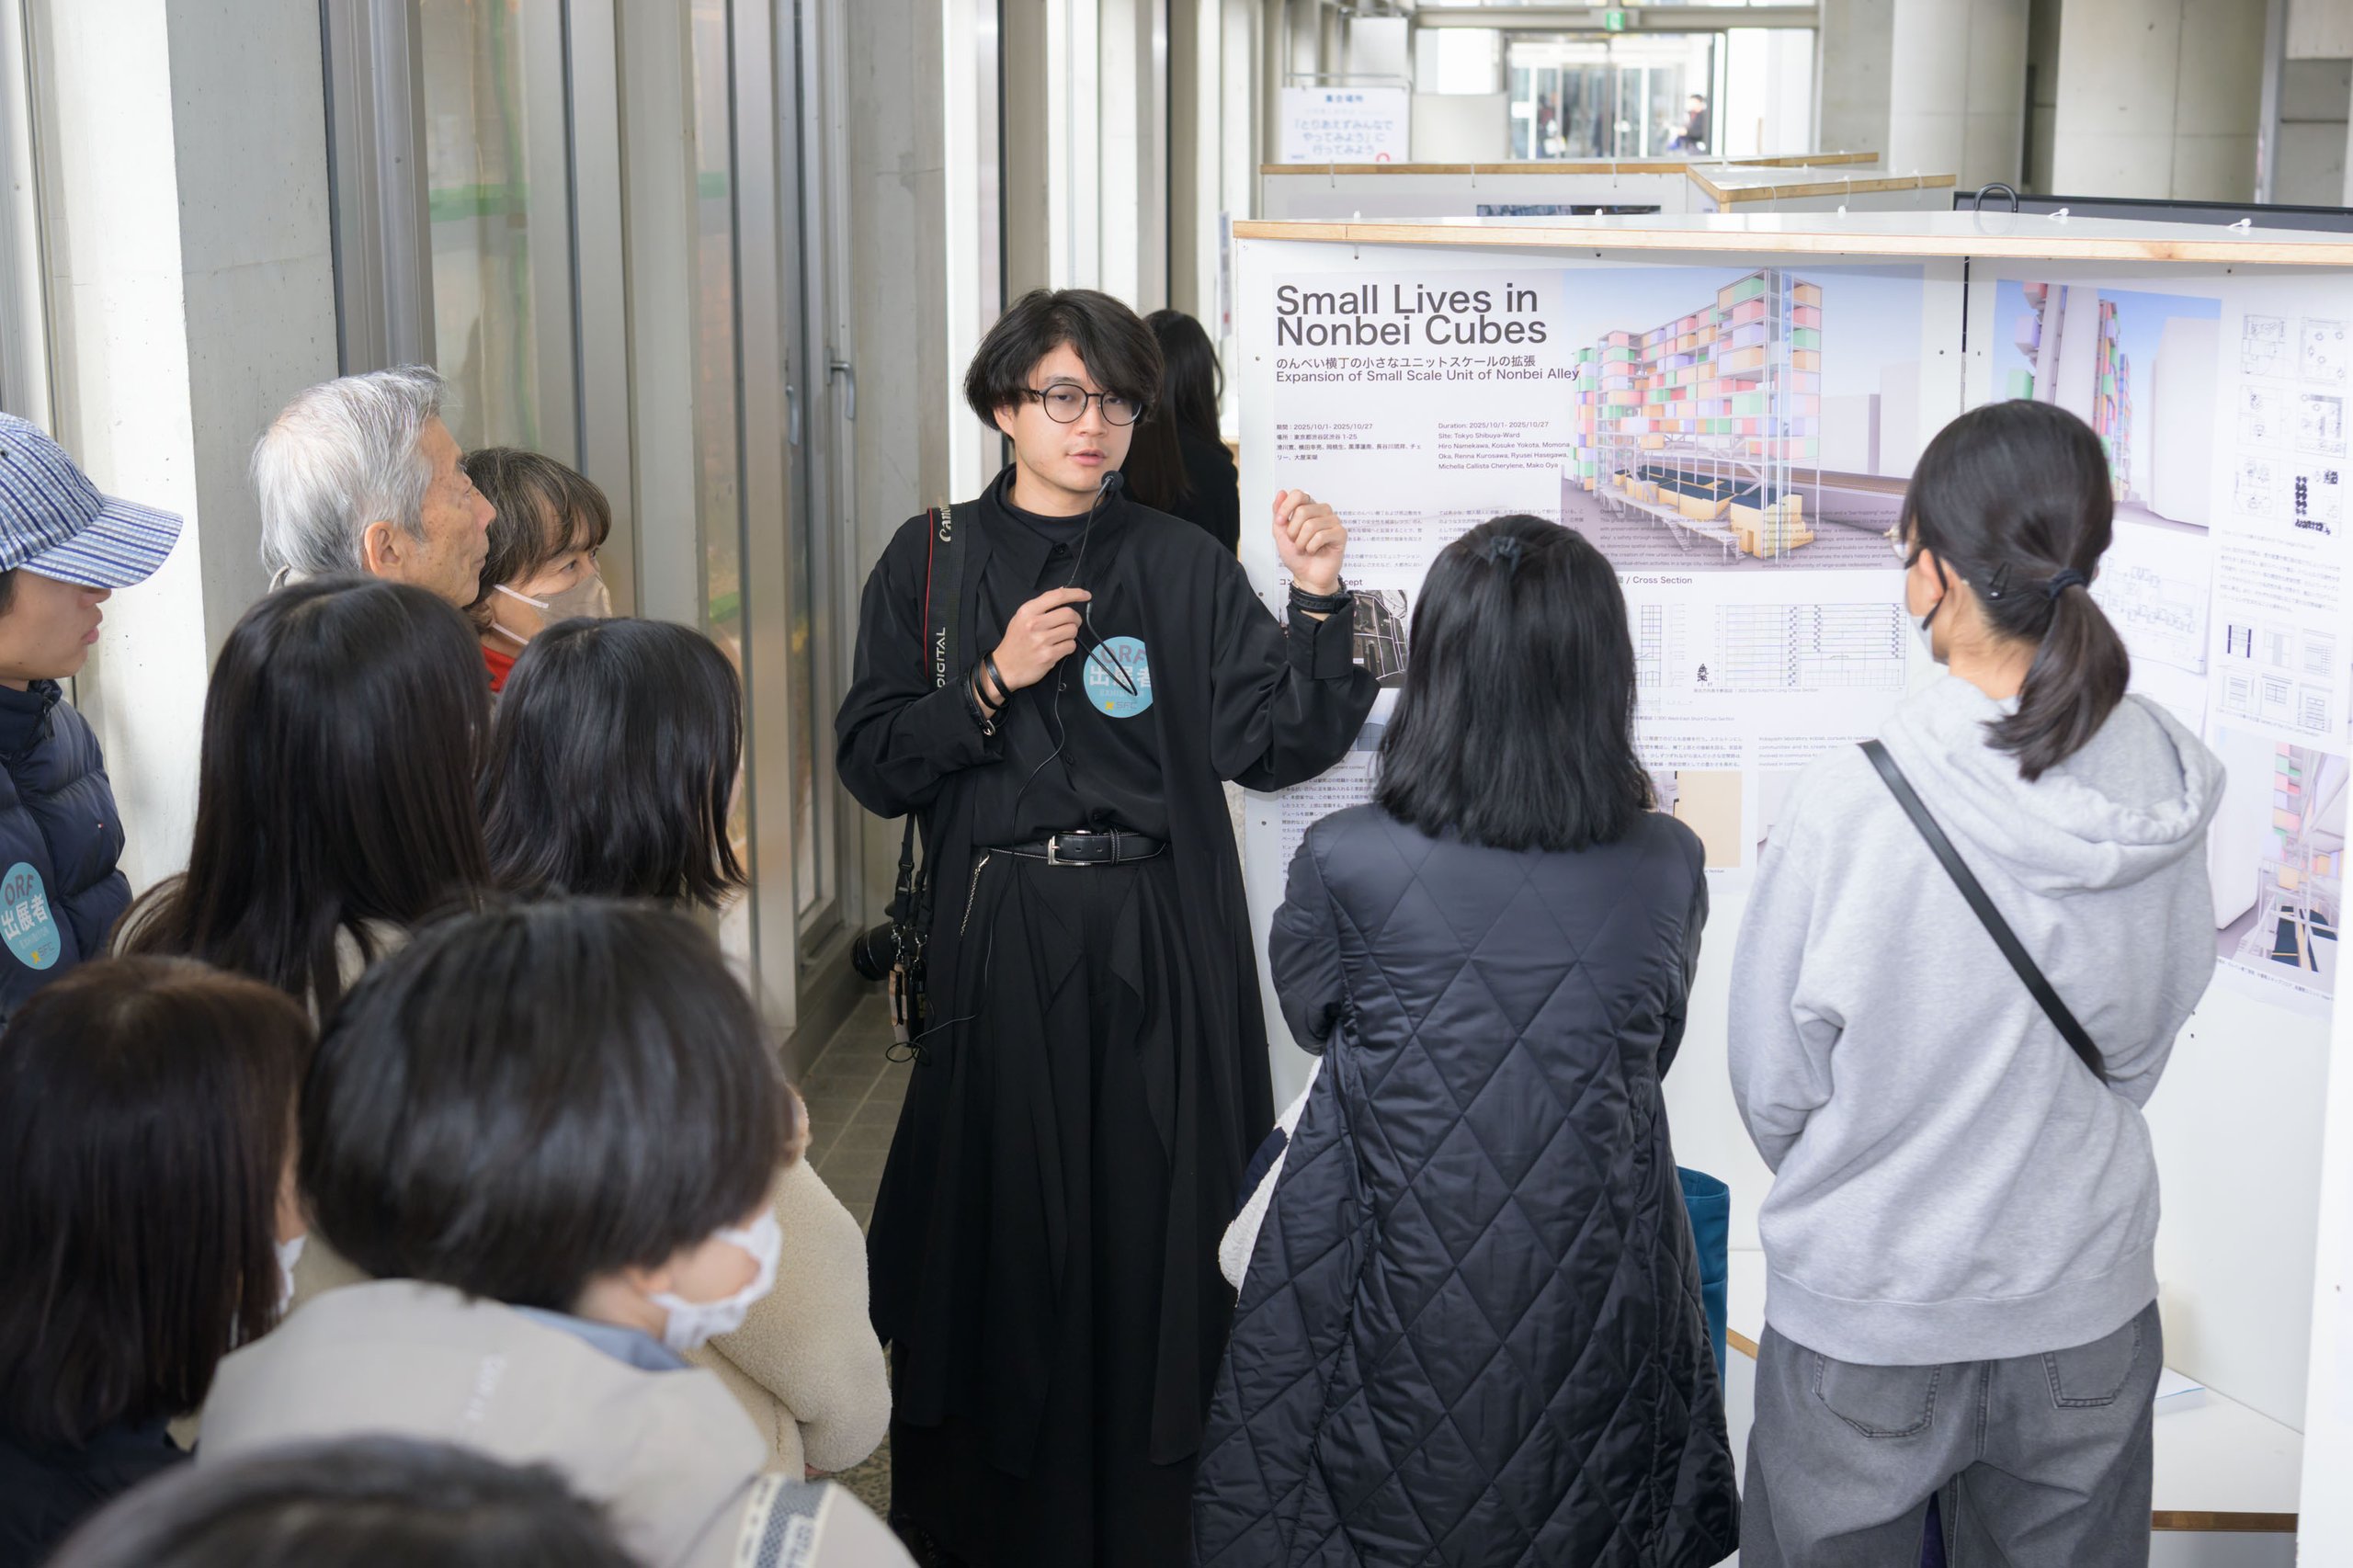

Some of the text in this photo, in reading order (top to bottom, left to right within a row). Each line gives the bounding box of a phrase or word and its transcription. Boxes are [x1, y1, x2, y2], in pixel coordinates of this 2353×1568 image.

[1277, 282, 1538, 315] Small Lives in
[1278, 313, 1547, 347] Nonbei Cubes
[1277, 355, 1536, 369] のんべい横丁の小さなユニットスケールの拡張
[1276, 368, 1580, 384] Expansion of Small Scale Unit of Nonbei Alley
[1533, 451, 1570, 460] Hasegawa,
[1660, 575, 1692, 584] Section
[936, 627, 946, 687] DIGITAL
[1089, 665, 1151, 688] 出展者
[4, 873, 34, 906] ORF
[1, 893, 48, 940] 出展者
[38, 941, 55, 957] SFC
